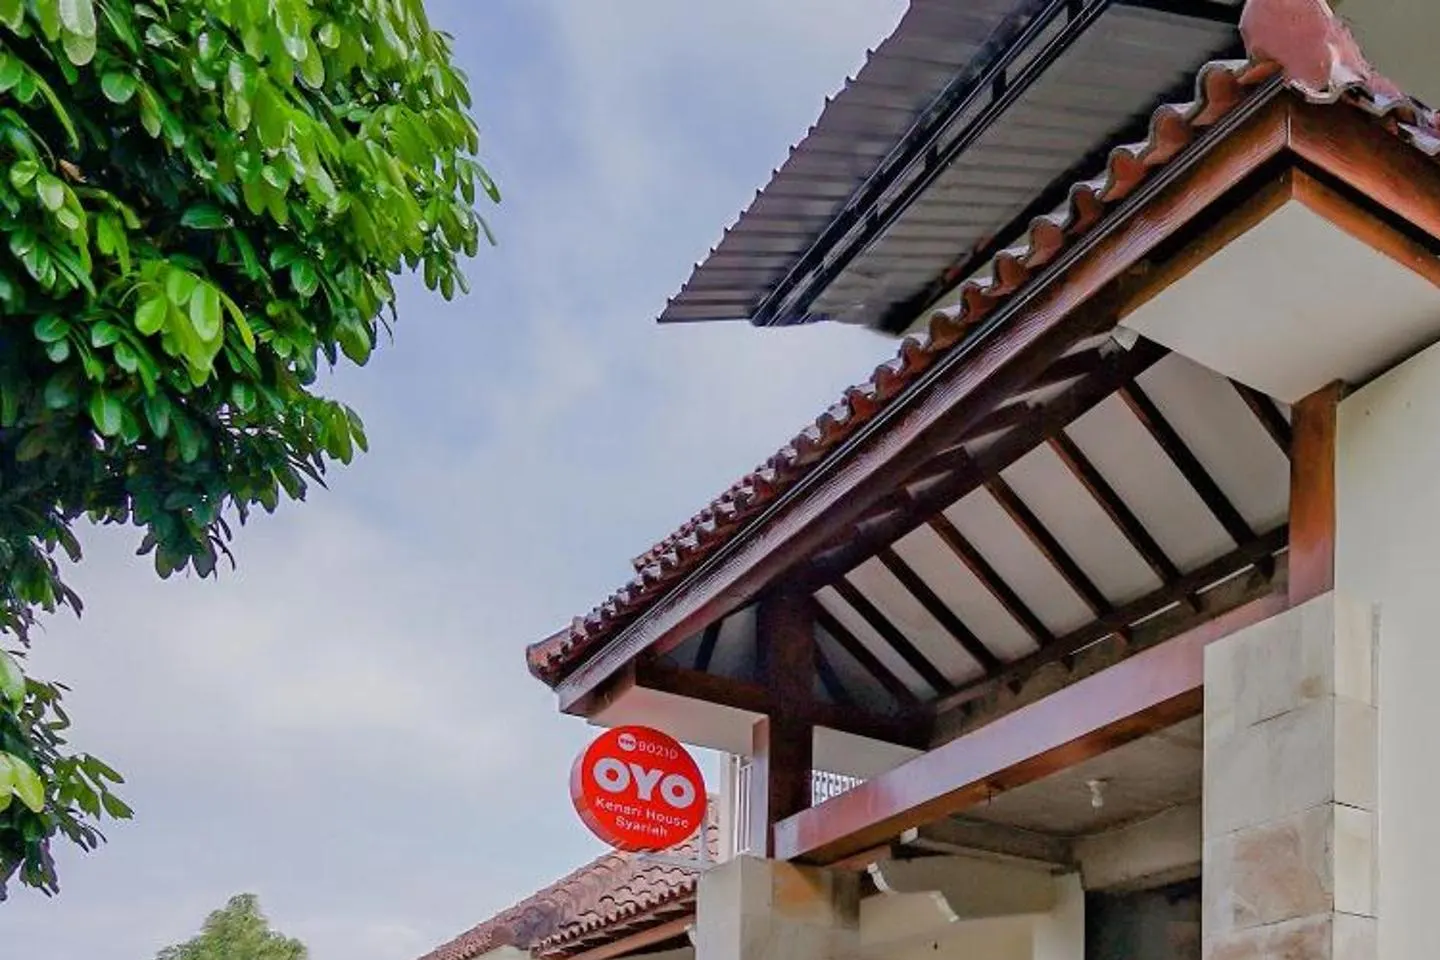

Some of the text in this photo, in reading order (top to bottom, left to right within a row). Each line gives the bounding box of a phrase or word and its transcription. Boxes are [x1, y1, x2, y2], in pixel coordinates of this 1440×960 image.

[592, 757, 696, 809] OYO
[595, 797, 689, 829] Kenari House
[615, 815, 668, 838] Syariah
